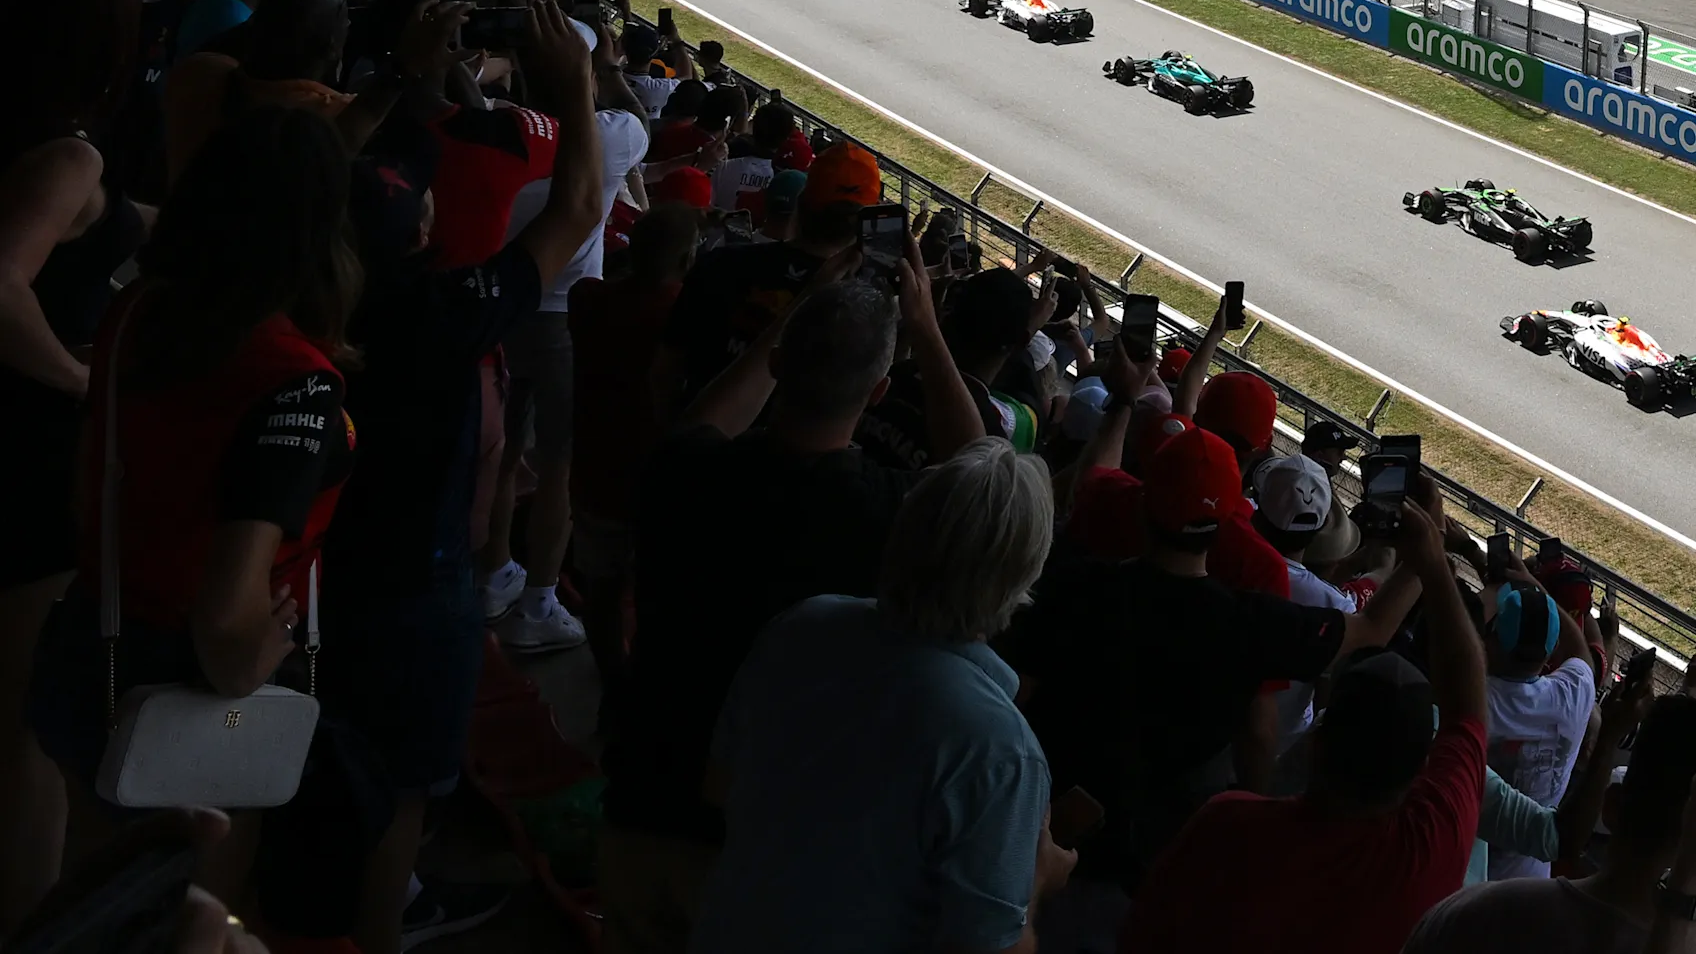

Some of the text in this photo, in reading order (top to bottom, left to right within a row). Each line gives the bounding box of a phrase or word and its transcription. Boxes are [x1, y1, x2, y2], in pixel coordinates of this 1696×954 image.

[1406, 22, 1525, 89] aramco
[1582, 342, 1606, 369] VISA
[268, 413, 326, 430] MAHLE
